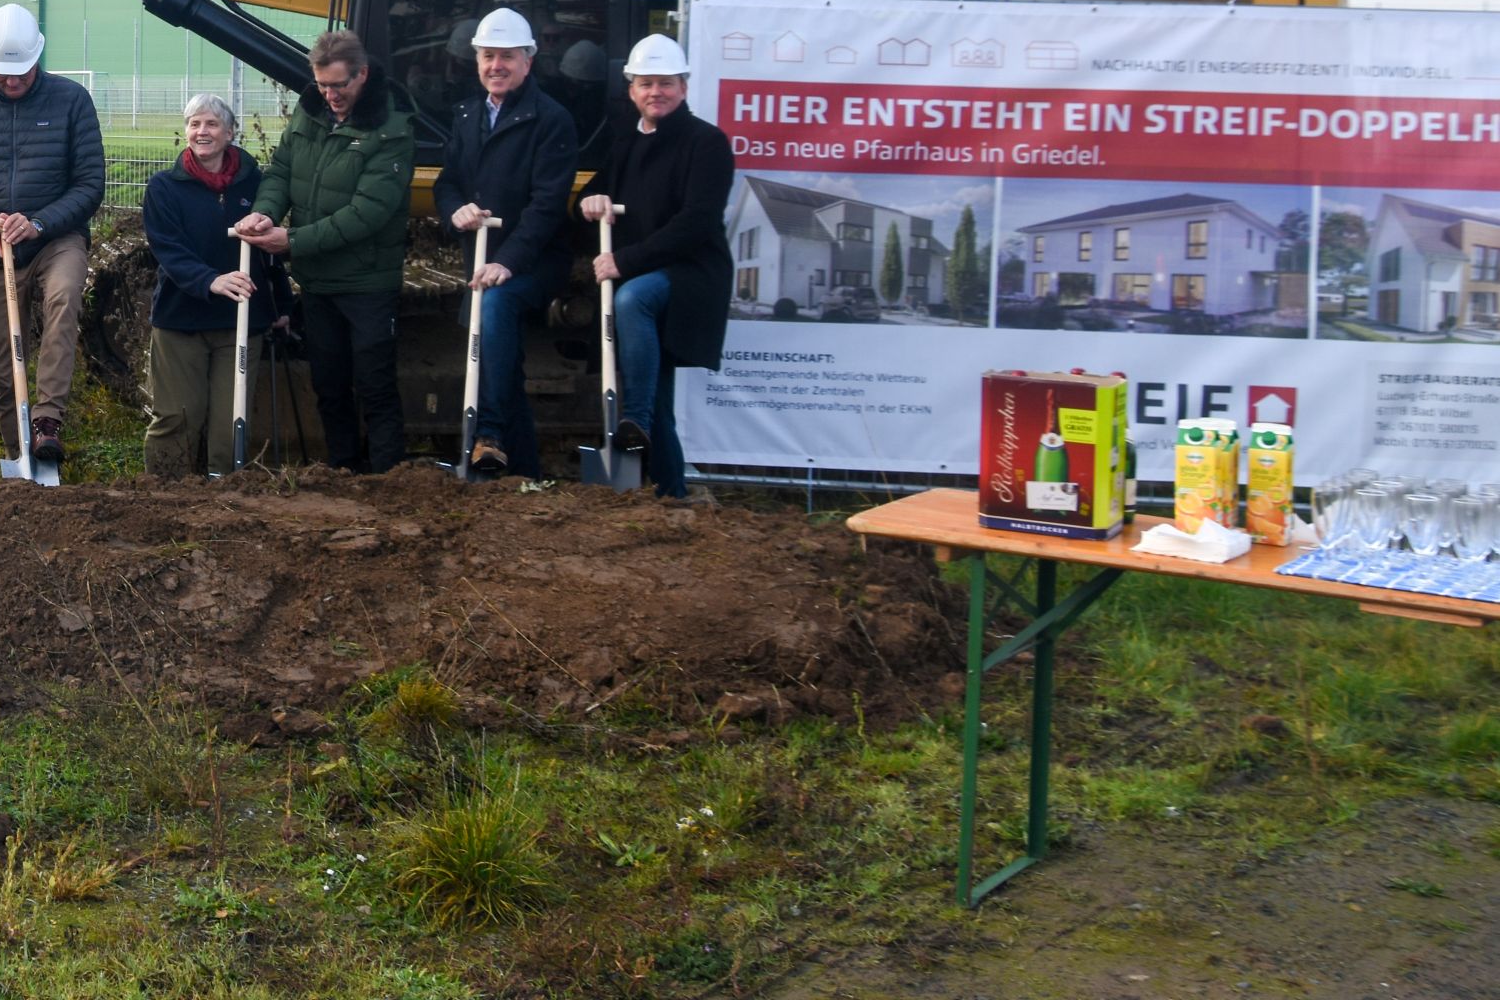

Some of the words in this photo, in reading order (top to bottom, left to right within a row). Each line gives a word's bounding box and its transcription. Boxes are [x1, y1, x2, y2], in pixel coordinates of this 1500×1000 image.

[1091, 58, 1186, 73] NACHHALTIG
[1200, 60, 1340, 78] ENERGIEEFFIZIENT
[1353, 64, 1452, 80] INDIVIDUELL
[733, 93, 828, 125] HIER
[842, 97, 1051, 131] ENTSTEHT
[1063, 102, 1132, 133] EIN
[1143, 103, 1500, 143] STREIF-DOPPELH
[731, 135, 776, 156] Das
[784, 141, 845, 159] neue
[853, 138, 973, 162] Pfarrhaus
[981, 142, 1004, 163] in
[1011, 143, 1106, 166] Griedel.
[721, 350, 835, 364] UGEMEINSCHAFT:
[724, 366, 819, 381] Gesamtgemeinde
[877, 372, 928, 384] Wetterau
[706, 384, 766, 394] zusammen
[770, 384, 789, 394] mit
[791, 384, 810, 395] der
[878, 403, 897, 414] der
[1136, 382, 1233, 425] EIF
[1011, 522, 1069, 534] HALBTROCKEN
